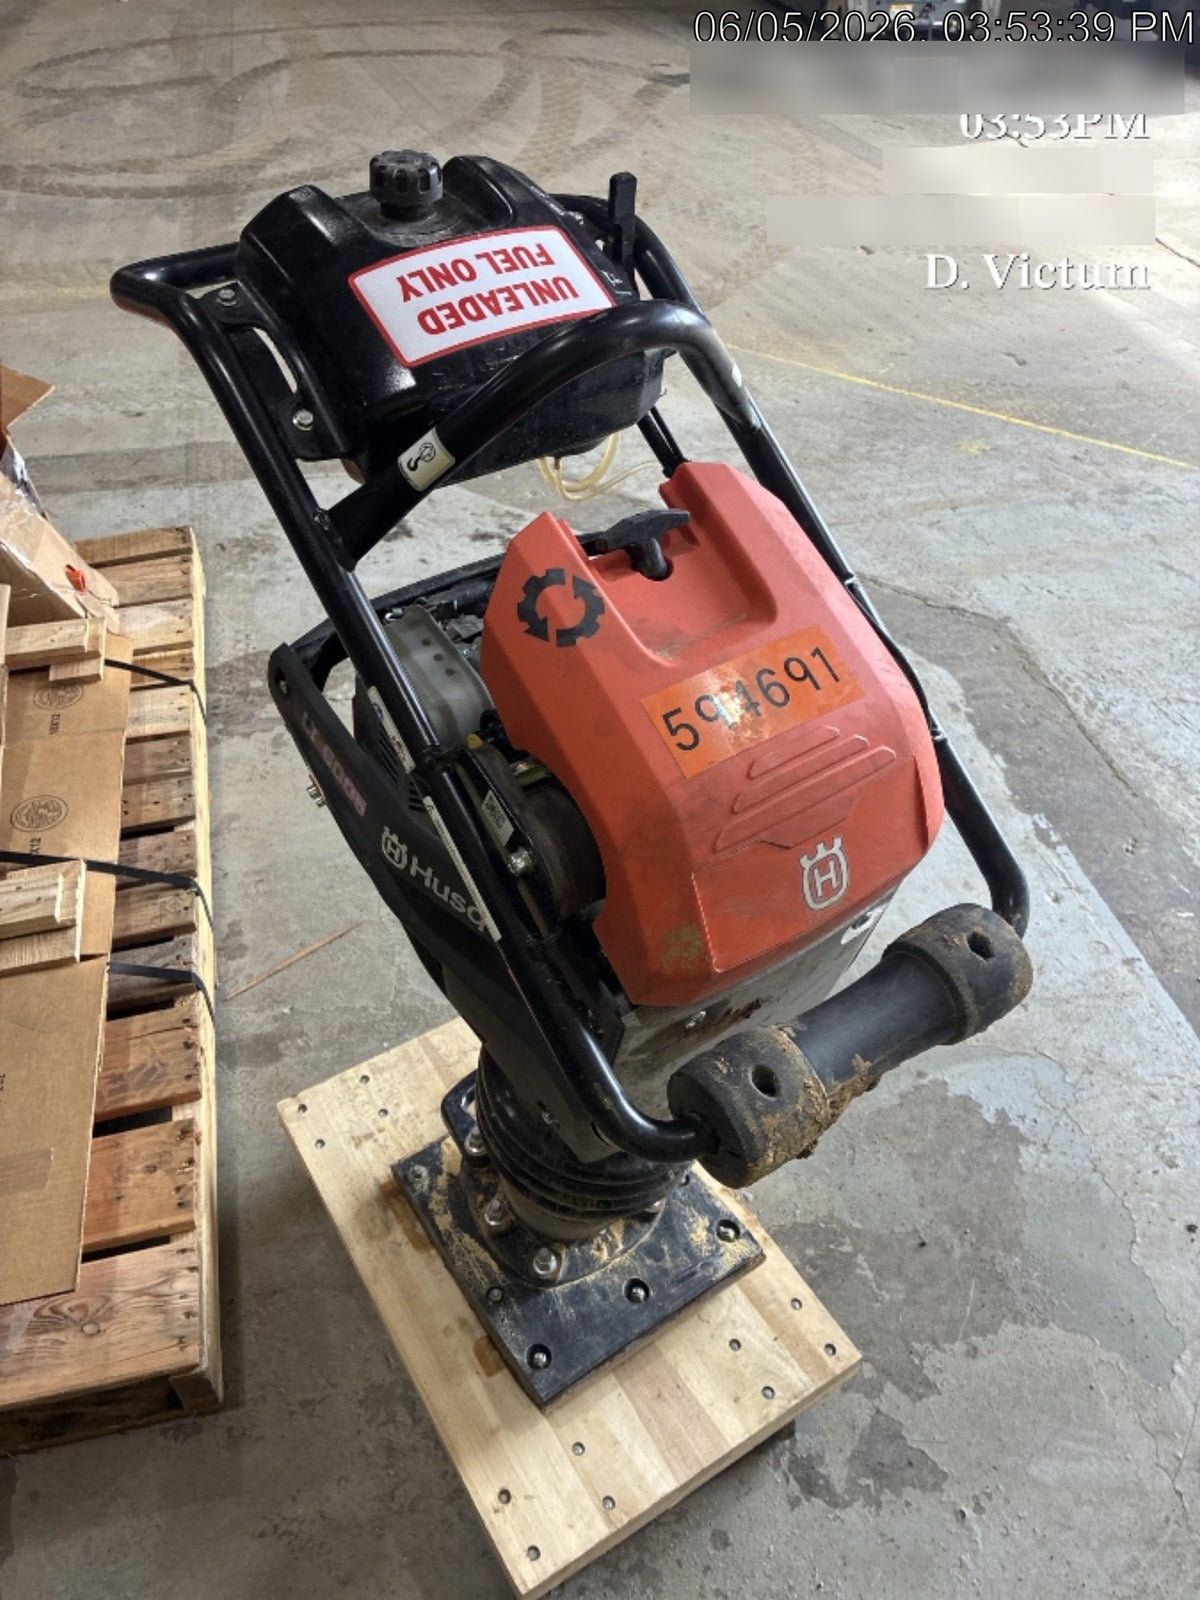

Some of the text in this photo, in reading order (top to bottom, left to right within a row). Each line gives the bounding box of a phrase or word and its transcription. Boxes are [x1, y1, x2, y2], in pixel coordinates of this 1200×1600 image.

[397, 243, 555, 302] FUEL ONLY
[417, 276, 580, 335] UNLEADED
[661, 647, 840, 751] 594691
